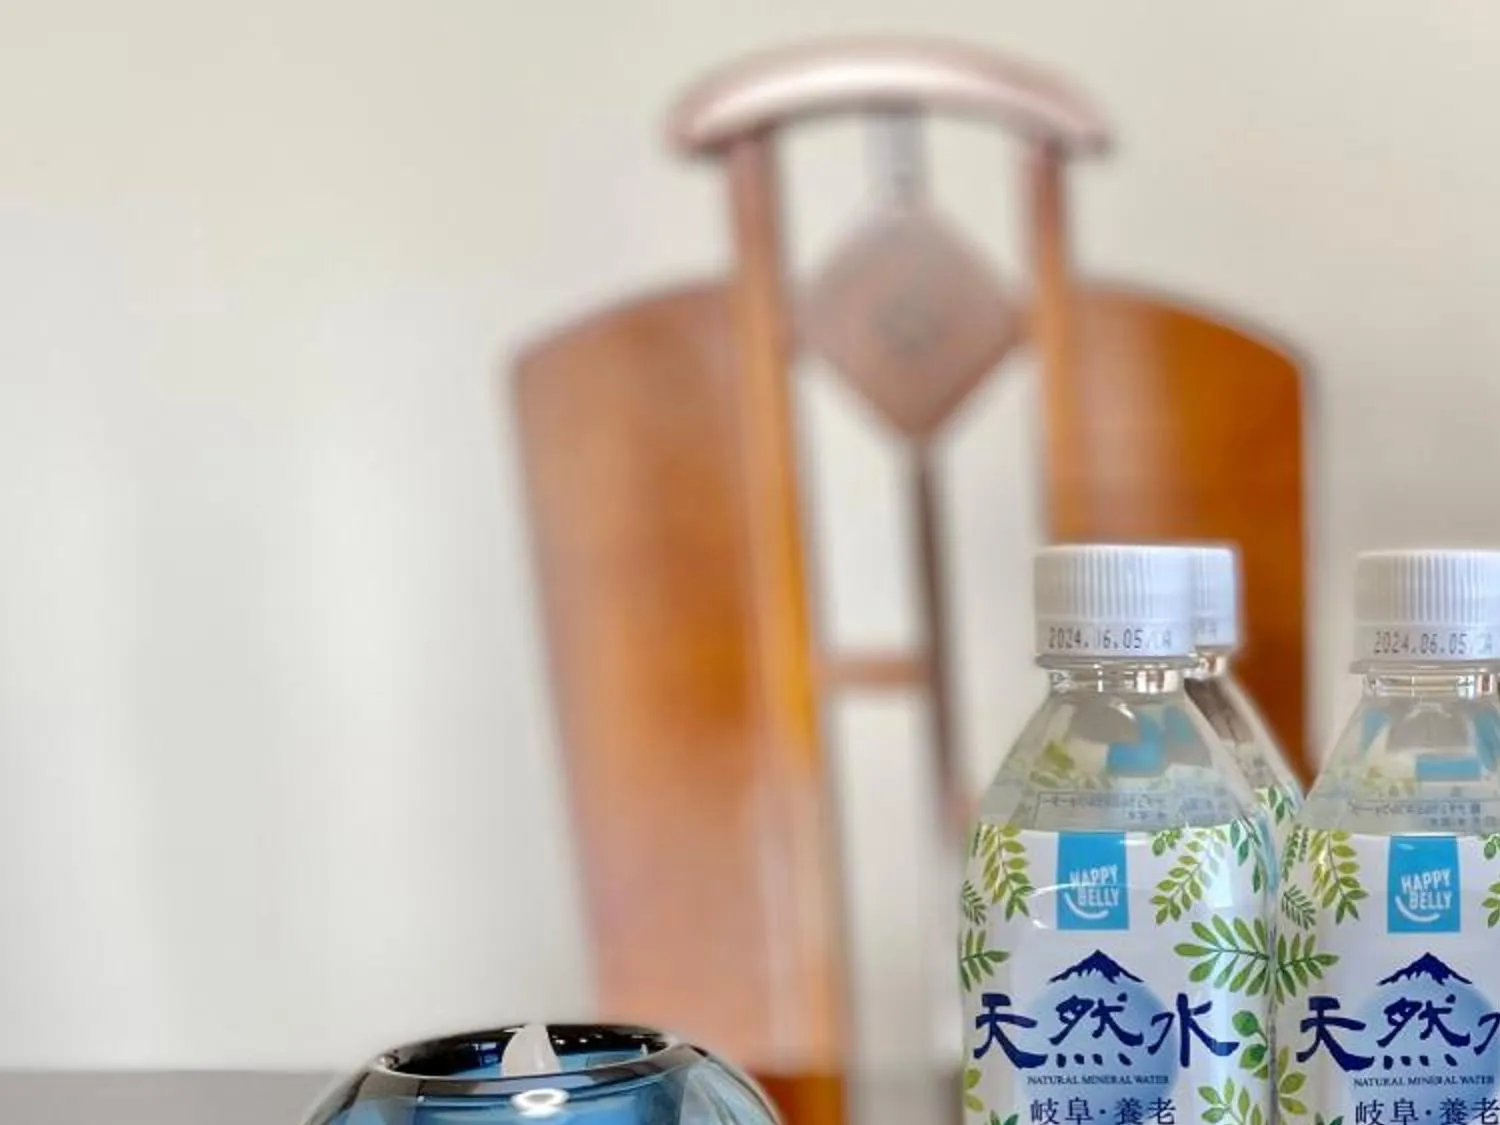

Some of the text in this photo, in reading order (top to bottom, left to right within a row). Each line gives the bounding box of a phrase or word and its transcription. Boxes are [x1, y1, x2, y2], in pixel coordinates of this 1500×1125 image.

[1068, 863, 1119, 891] HAPPY
[1400, 868, 1452, 892] HAPPY
[1076, 885, 1121, 908] BELLY
[1408, 889, 1453, 911] BELLY
[972, 992, 1241, 1070] 天然水
[1026, 1074, 1169, 1086] NATURAL MINERAL WATER
[1352, 1075, 1495, 1088] NATURAL MINERAL WATER
